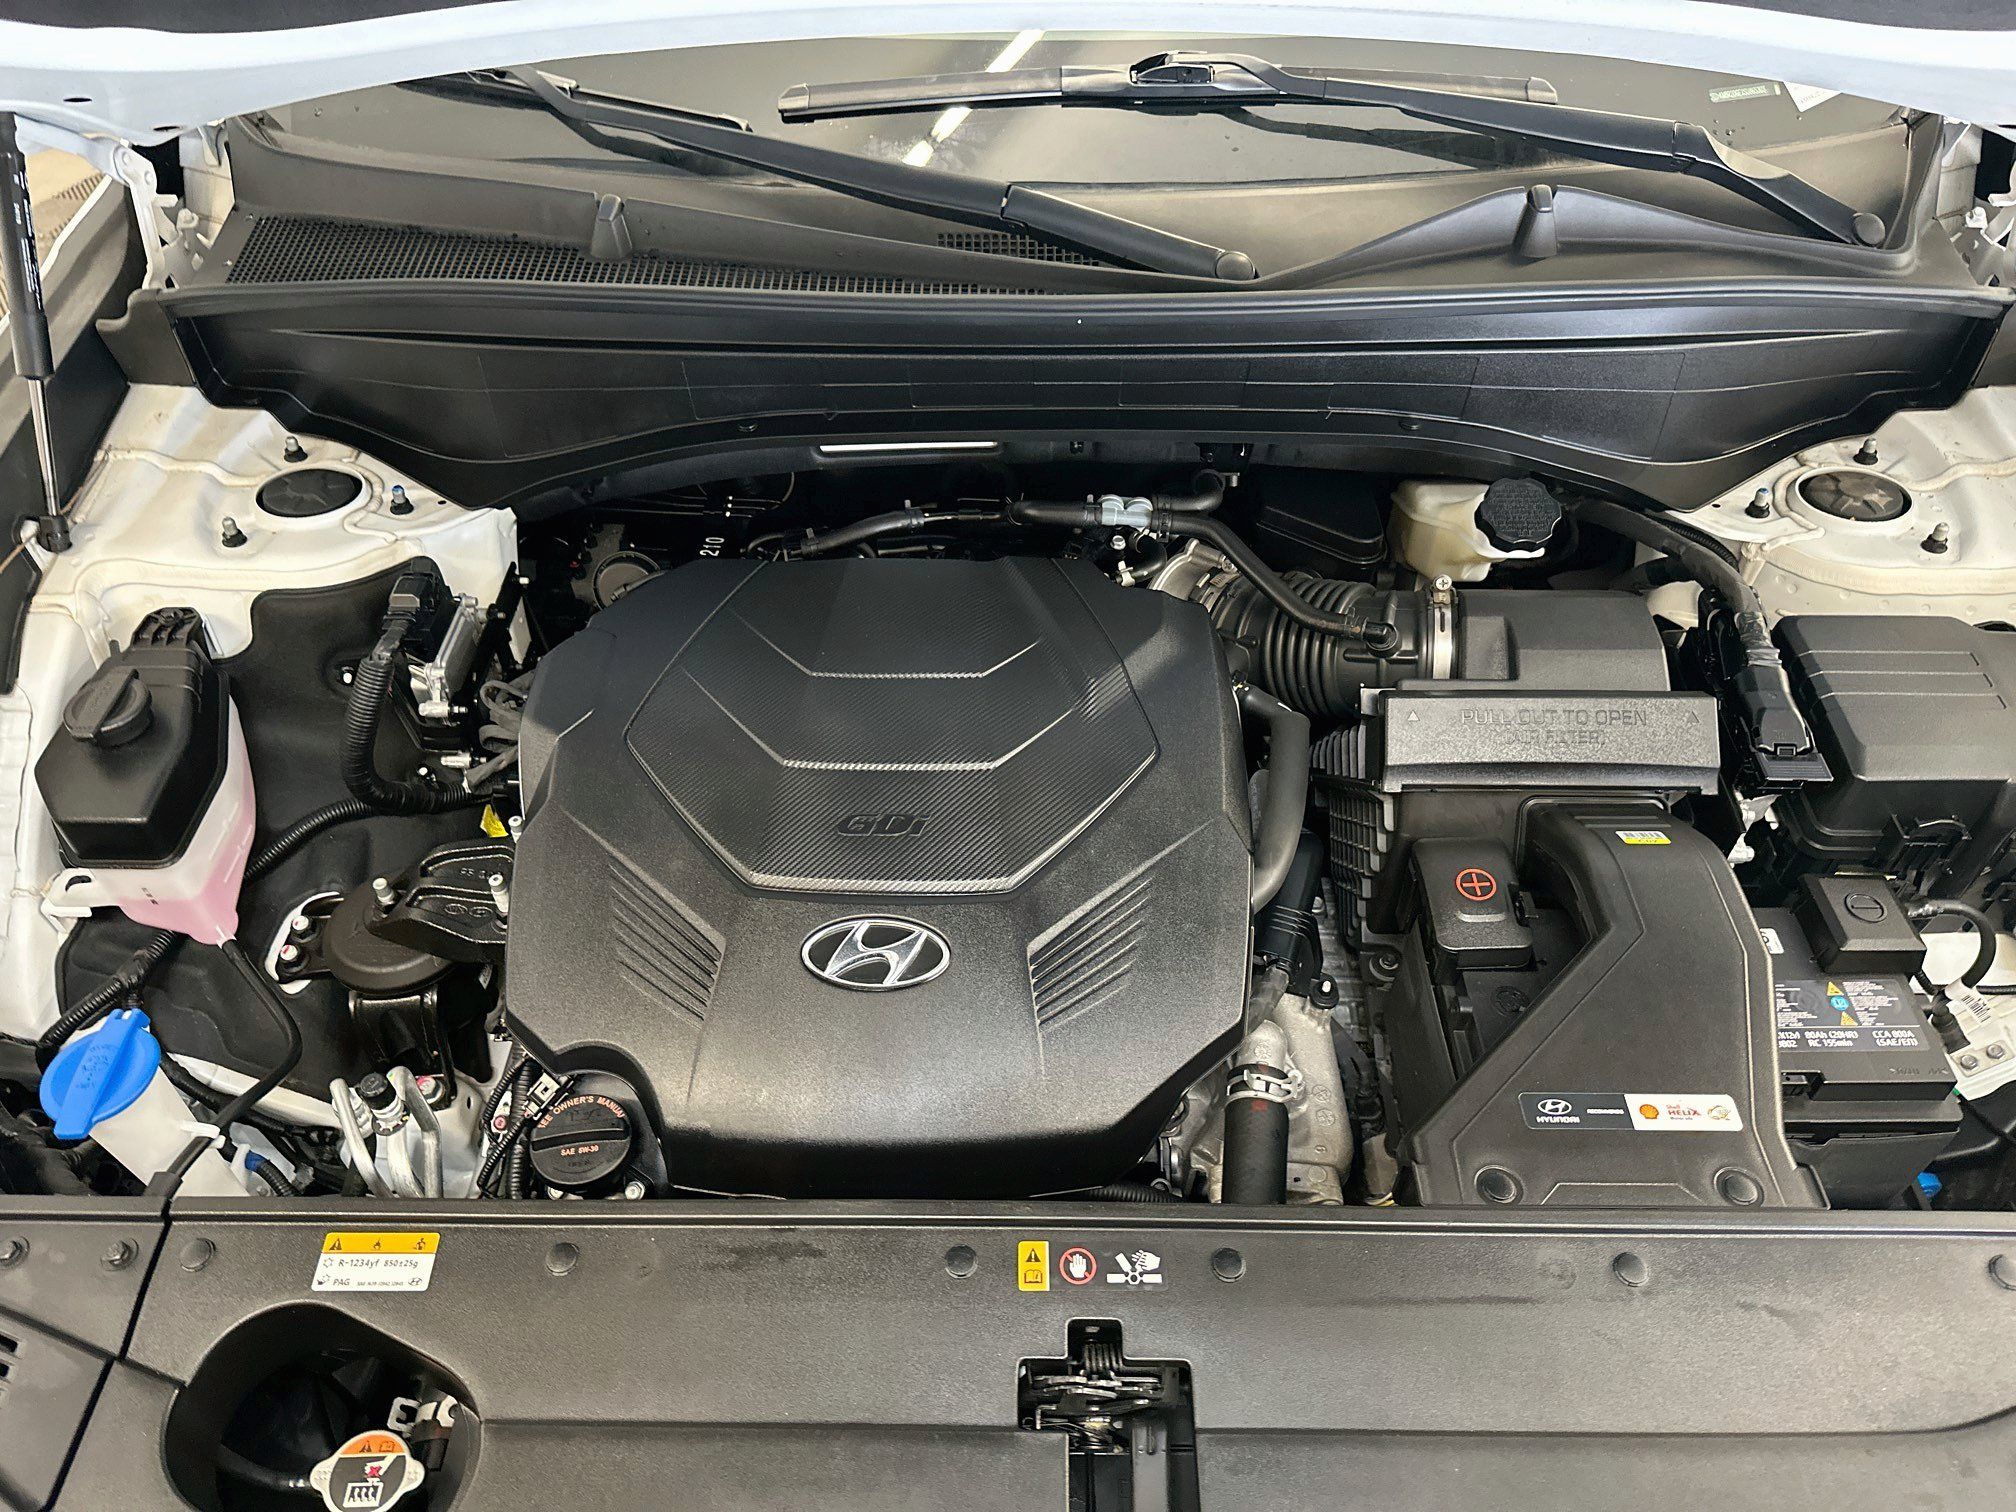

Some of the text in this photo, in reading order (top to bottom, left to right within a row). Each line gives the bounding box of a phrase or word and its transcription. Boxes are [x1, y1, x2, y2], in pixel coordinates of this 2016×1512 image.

[700, 537, 725, 557] 210
[1461, 709, 1648, 726] PULL OUT TO OPEN
[838, 813, 931, 837] GDi
[1805, 1031, 1828, 1039] 80Ah
[1872, 1030, 1891, 1038] CCA
[1808, 1039, 1822, 1047] RC
[1822, 1038, 1854, 1047] 155min
[552, 1095, 595, 1115] OWNER'S
[1667, 1107, 1702, 1116] HELIX
[1536, 1115, 1580, 1124] HYUNDAI
[560, 1144, 600, 1156] SAE 5W-30
[338, 1258, 419, 1270] R-1234yf 850±25g
[332, 1278, 351, 1287] PAG
